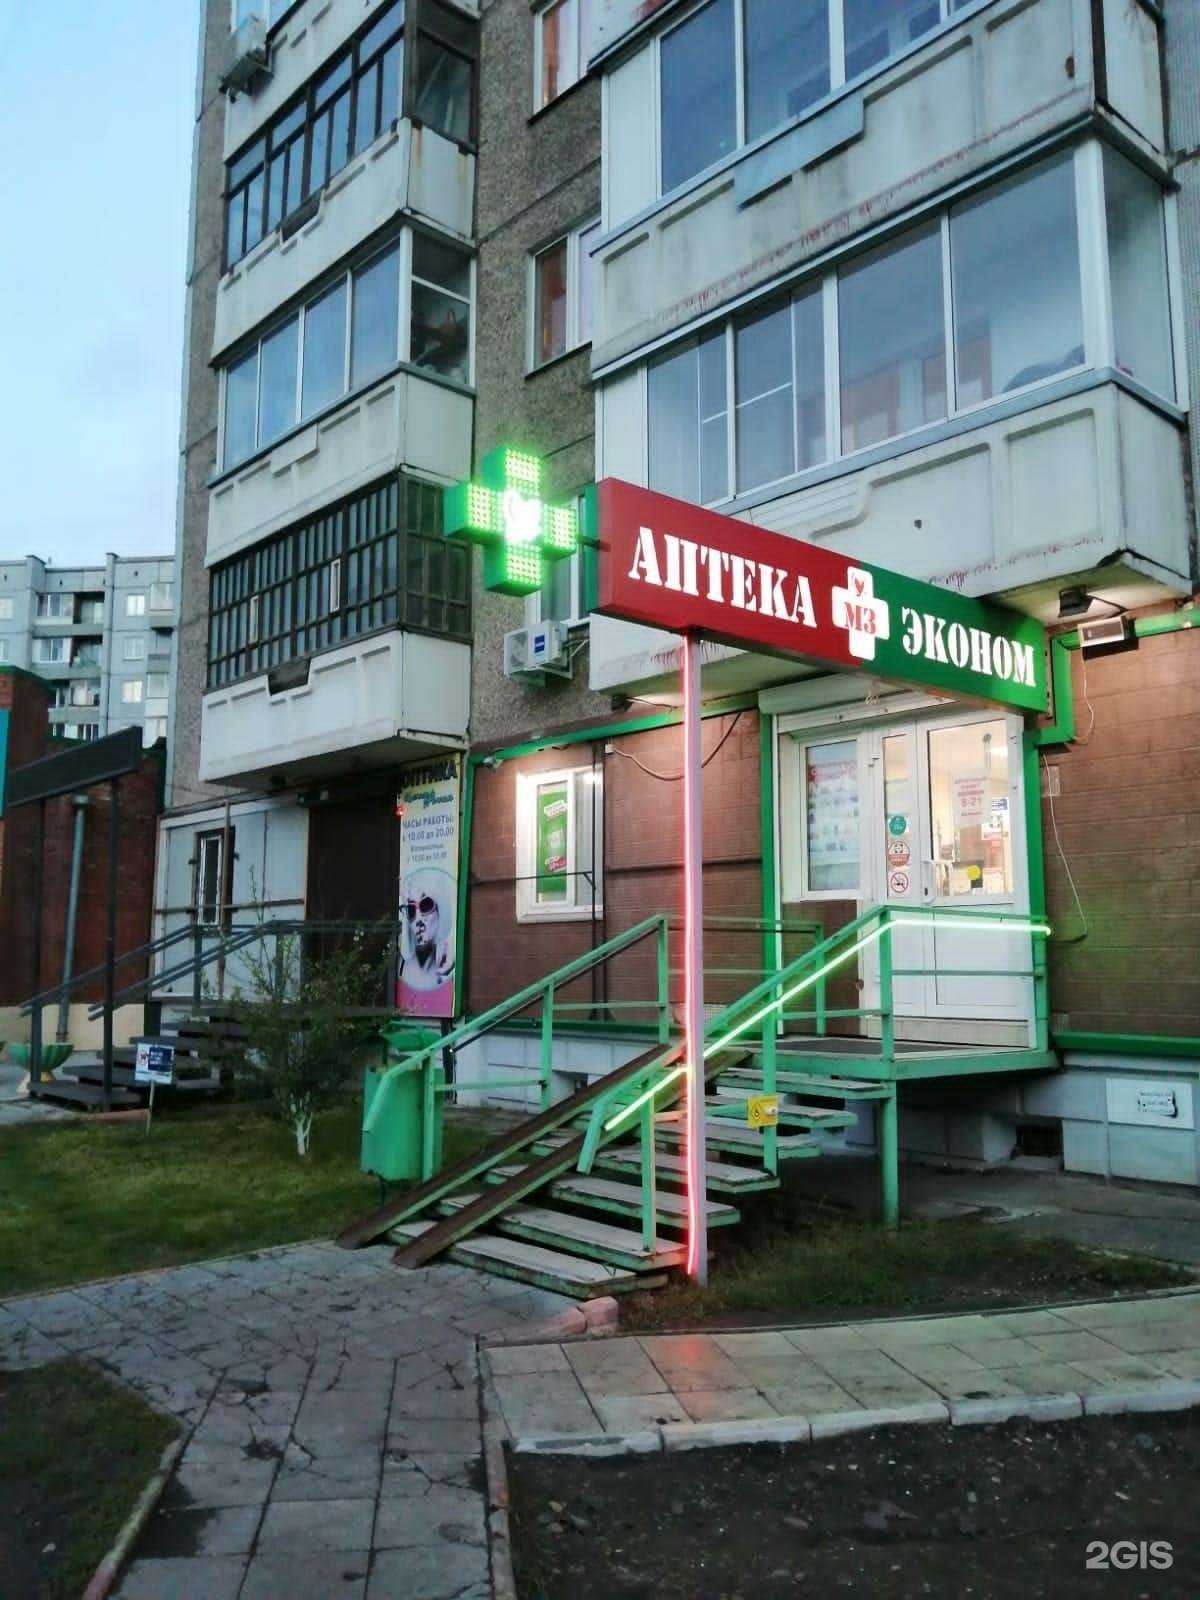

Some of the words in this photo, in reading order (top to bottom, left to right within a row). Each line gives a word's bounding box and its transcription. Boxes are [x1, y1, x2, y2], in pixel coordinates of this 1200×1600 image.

[628, 526, 818, 629] АПТЕКА
[902, 606, 1036, 687] ЭКОНОМ
[403, 817, 422, 829] ЧАСЫ
